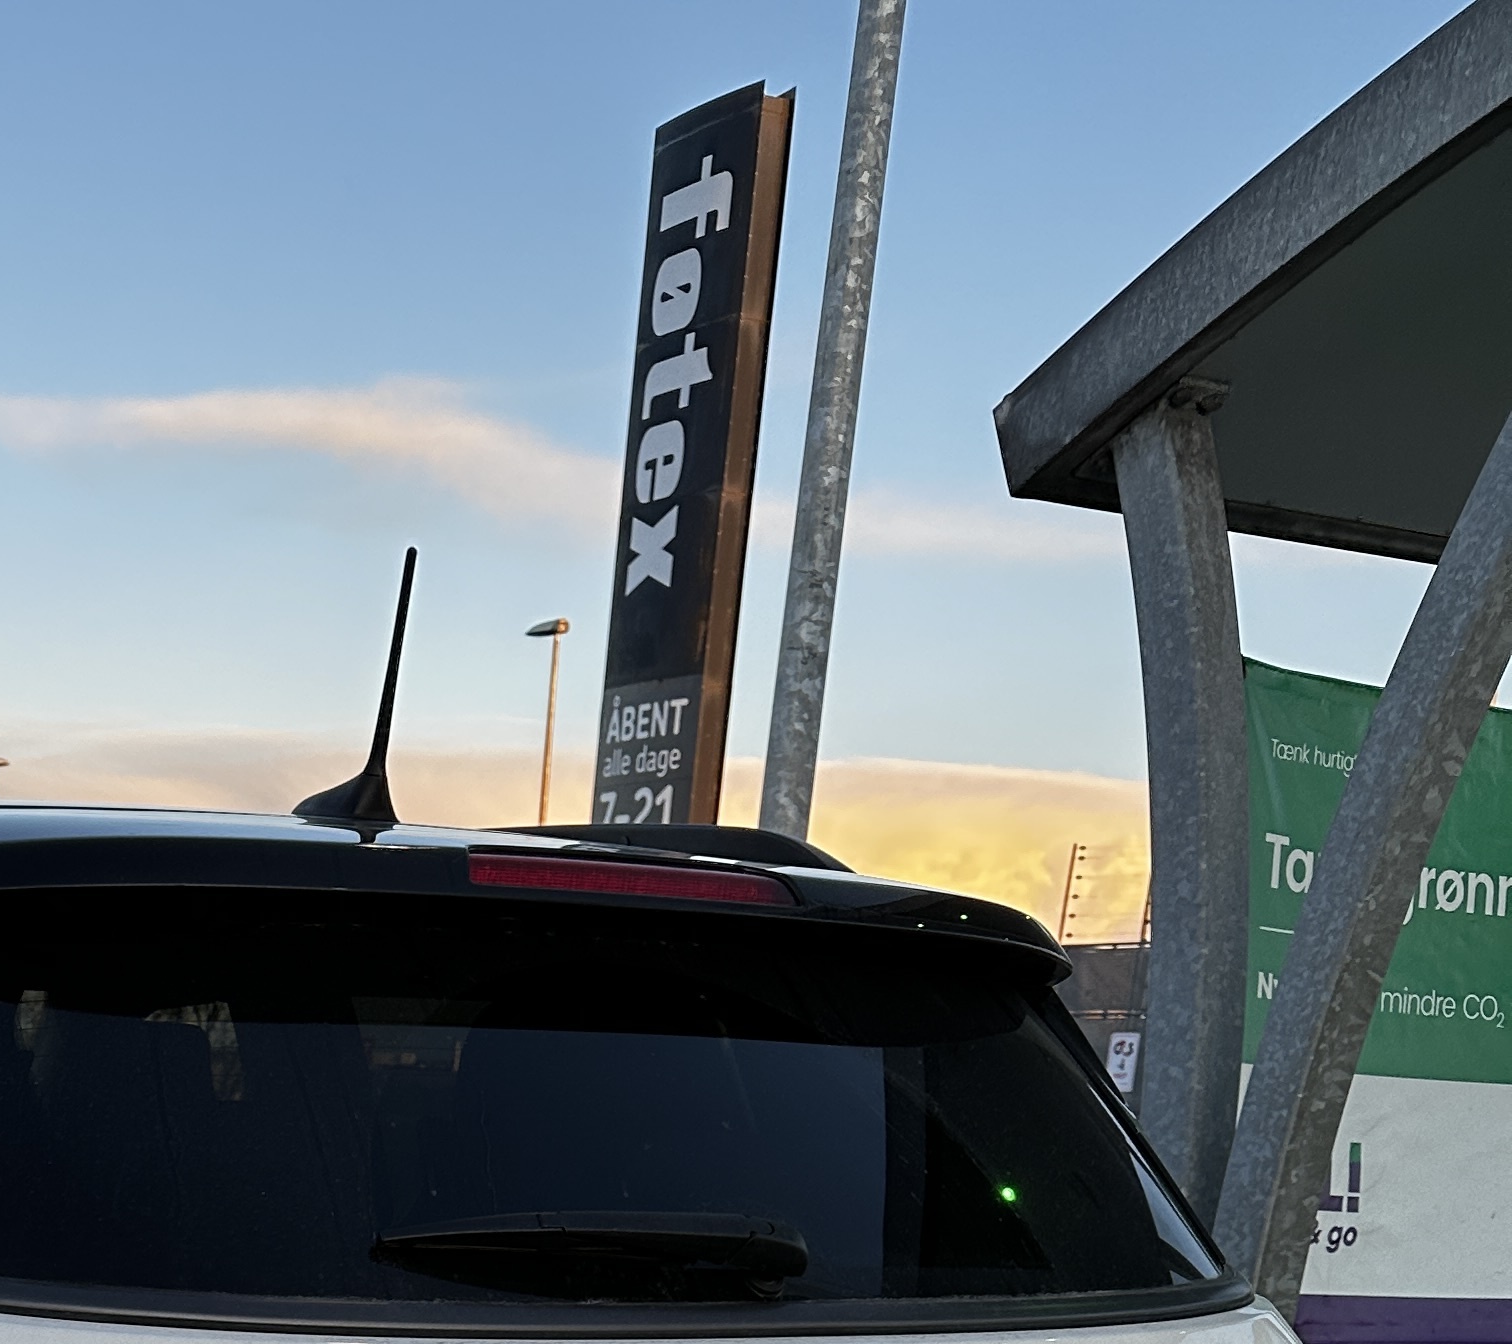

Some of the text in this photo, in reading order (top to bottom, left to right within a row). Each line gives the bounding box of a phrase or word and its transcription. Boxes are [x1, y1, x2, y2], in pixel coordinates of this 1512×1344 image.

[624, 154, 734, 597] føtex
[605, 694, 690, 744] ÅBENT
[602, 743, 683, 778] alle dage
[1270, 737, 1310, 764] Tænk
[599, 783, 675, 825] 7-21
[1380, 986, 1457, 1018] mindre
[1325, 1225, 1358, 1254] go
